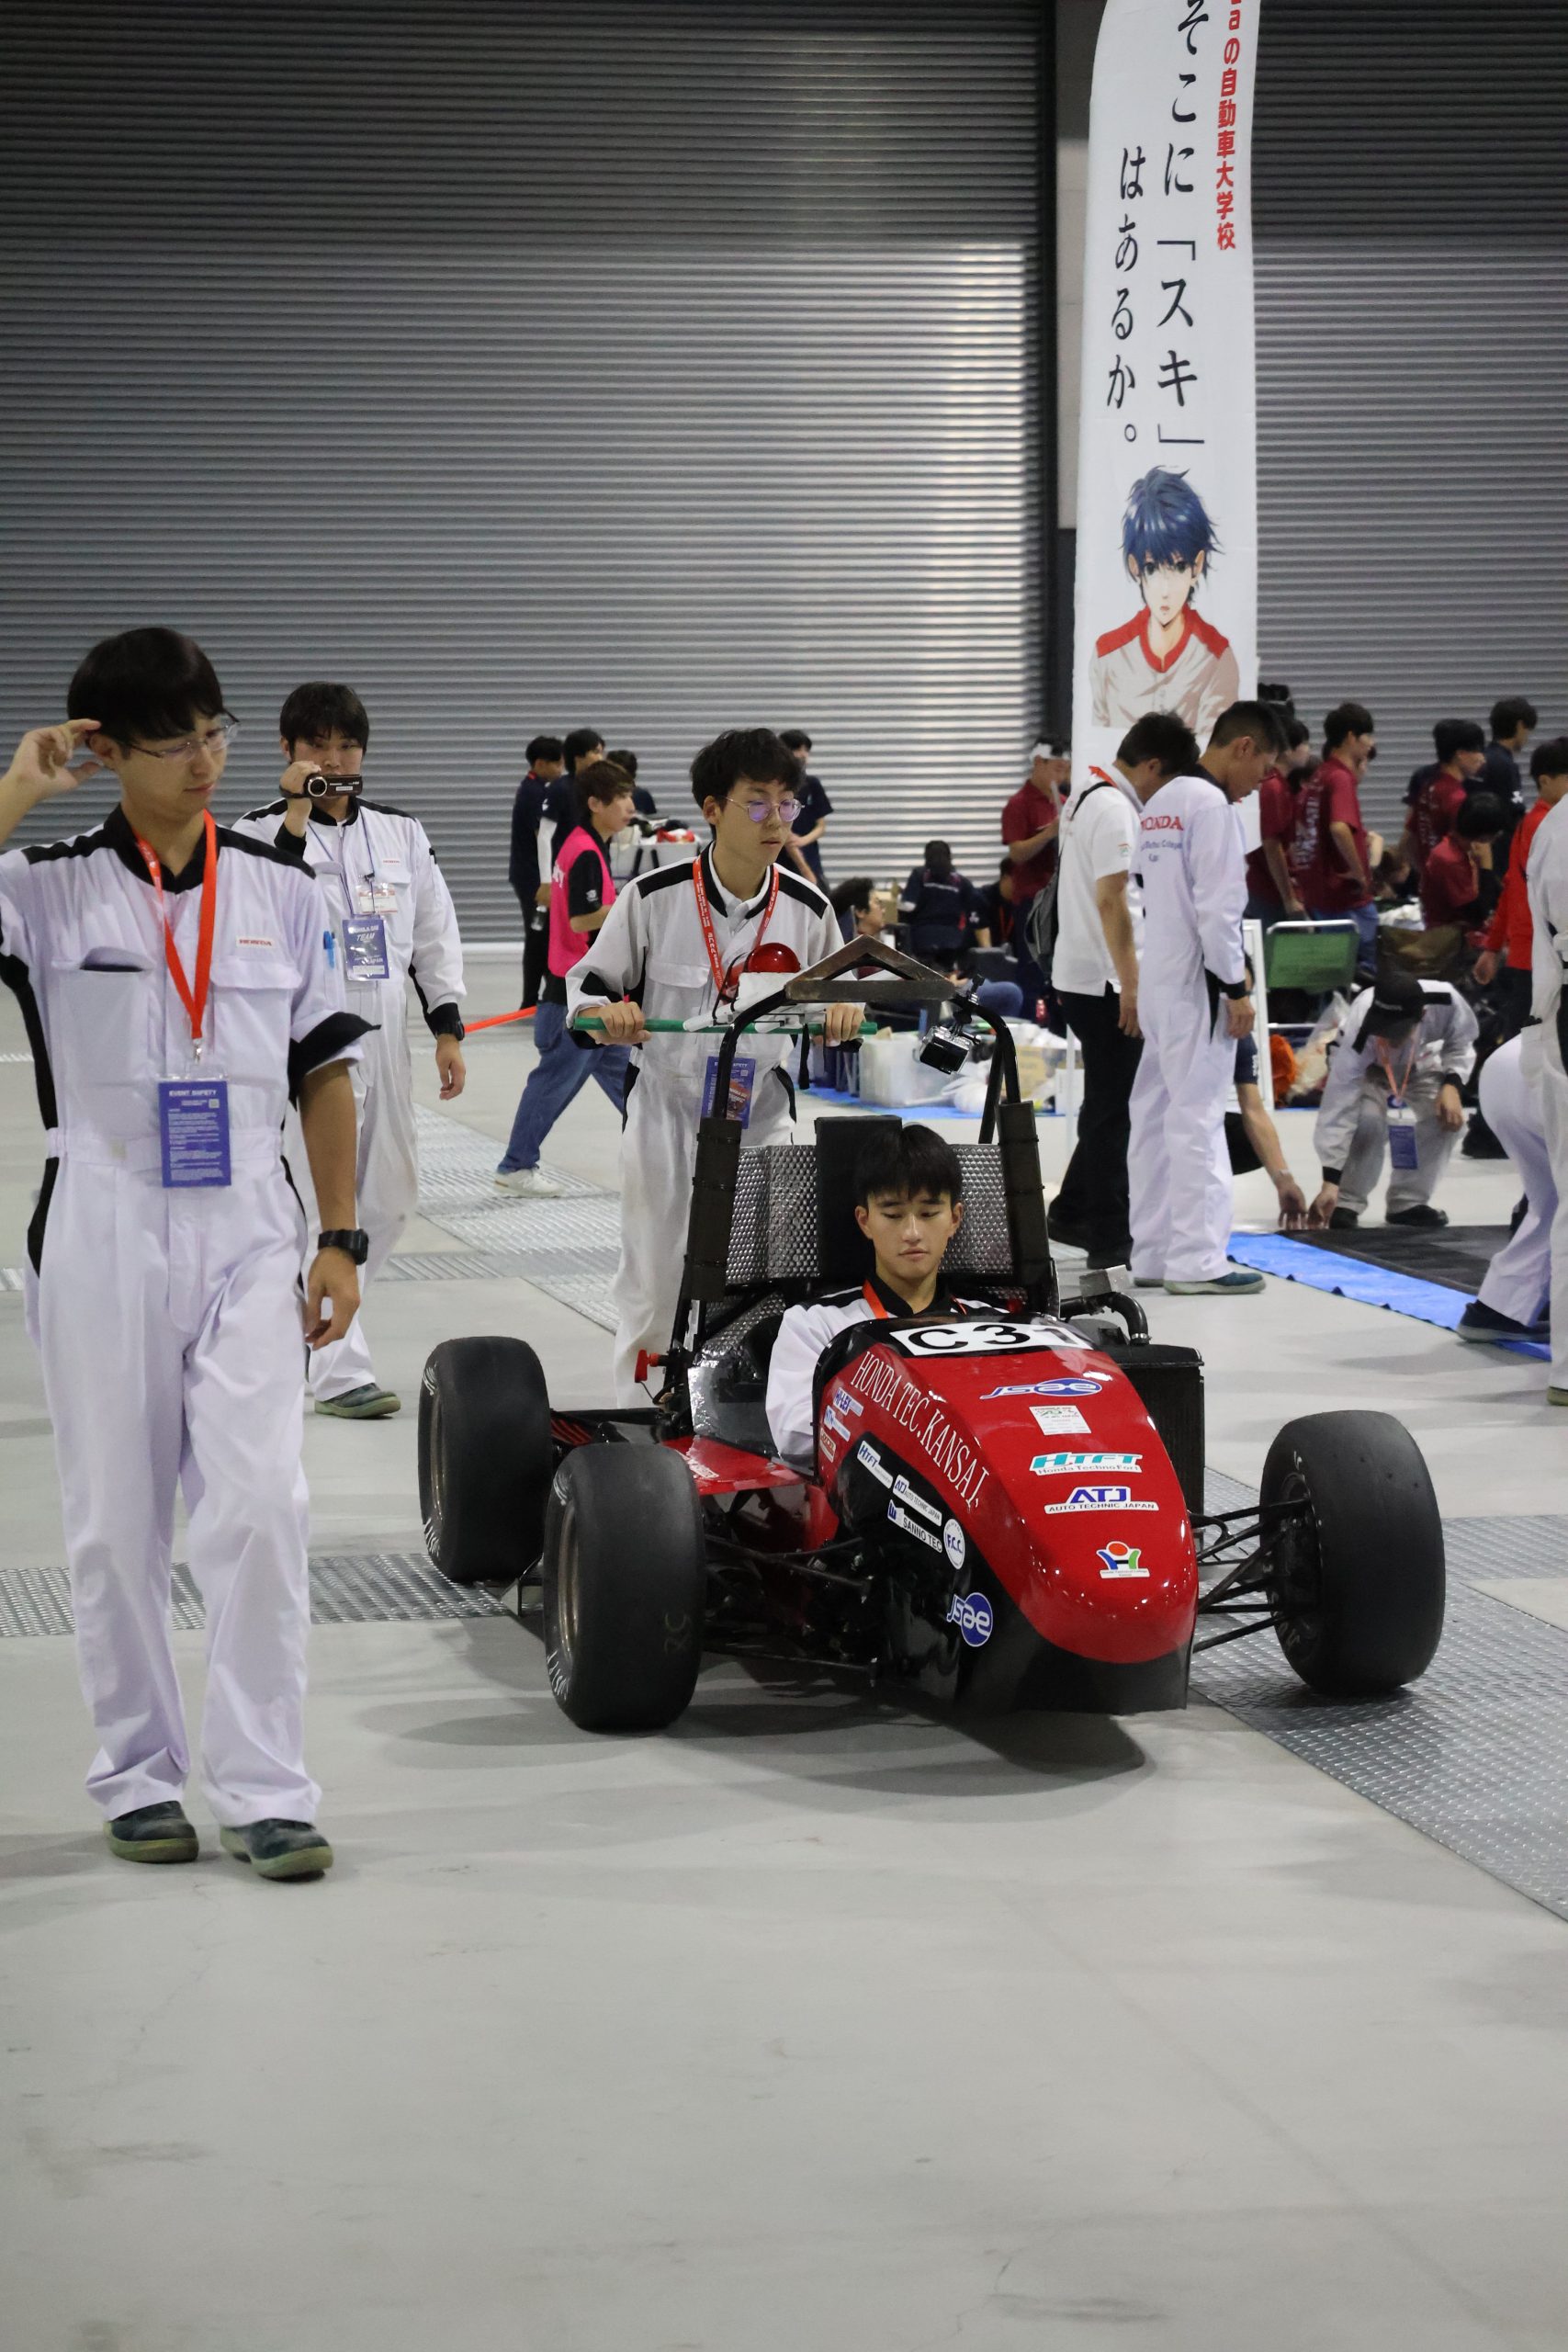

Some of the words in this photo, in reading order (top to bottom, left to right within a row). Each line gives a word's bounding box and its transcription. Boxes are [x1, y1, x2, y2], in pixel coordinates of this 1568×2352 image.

[1216, 0, 1241, 250] aの自動車大学校
[1107, 145, 1146, 443] はあるか。
[851, 1351, 902, 1411] HONDA
[1049, 1504, 1076, 1512] AUTO
[1070, 1488, 1127, 1503] ATJ
[903, 1517, 927, 1541] SANNO
[927, 1534, 942, 1551] TEC
